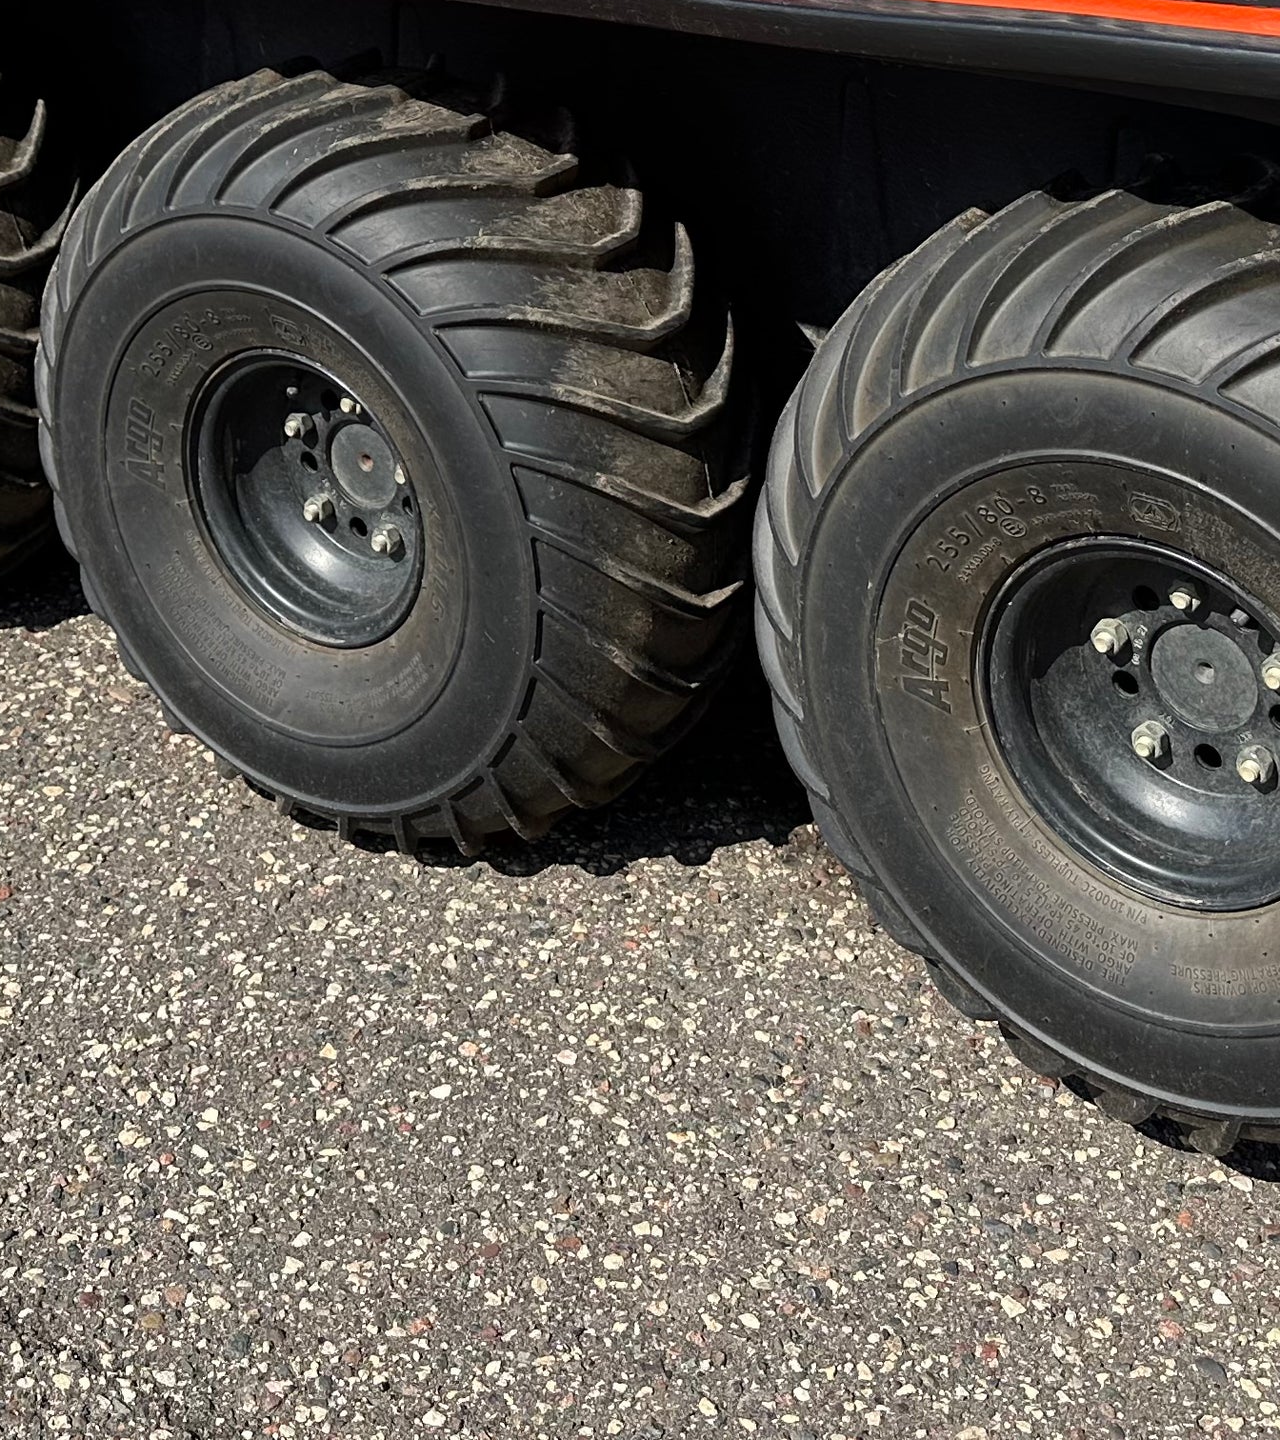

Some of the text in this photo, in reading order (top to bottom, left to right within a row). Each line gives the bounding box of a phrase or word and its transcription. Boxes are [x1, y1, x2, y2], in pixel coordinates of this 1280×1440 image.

[125, 396, 167, 491] Argo
[926, 486, 1048, 573] 255/80-8
[900, 596, 953, 716] Argo
[979, 764, 1009, 807] RATING
[1004, 808, 1023, 830] PLY
[1030, 838, 1080, 885] TUBELESS
[943, 826, 1125, 988] TIRE DESIGNED EXCLUSIVELY FOR
[946, 811, 1132, 976] ARGO WITH OPERATING PRESSURE
[1051, 893, 1105, 935] PRESSURE
[1079, 880, 1125, 914] 10002C
[1126, 905, 1147, 925] P/N
[1100, 939, 1116, 954] 10
[1118, 950, 1135, 963] OF
[1167, 962, 1227, 982] PRESSURE
[1193, 981, 1247, 998] OWNER'S
